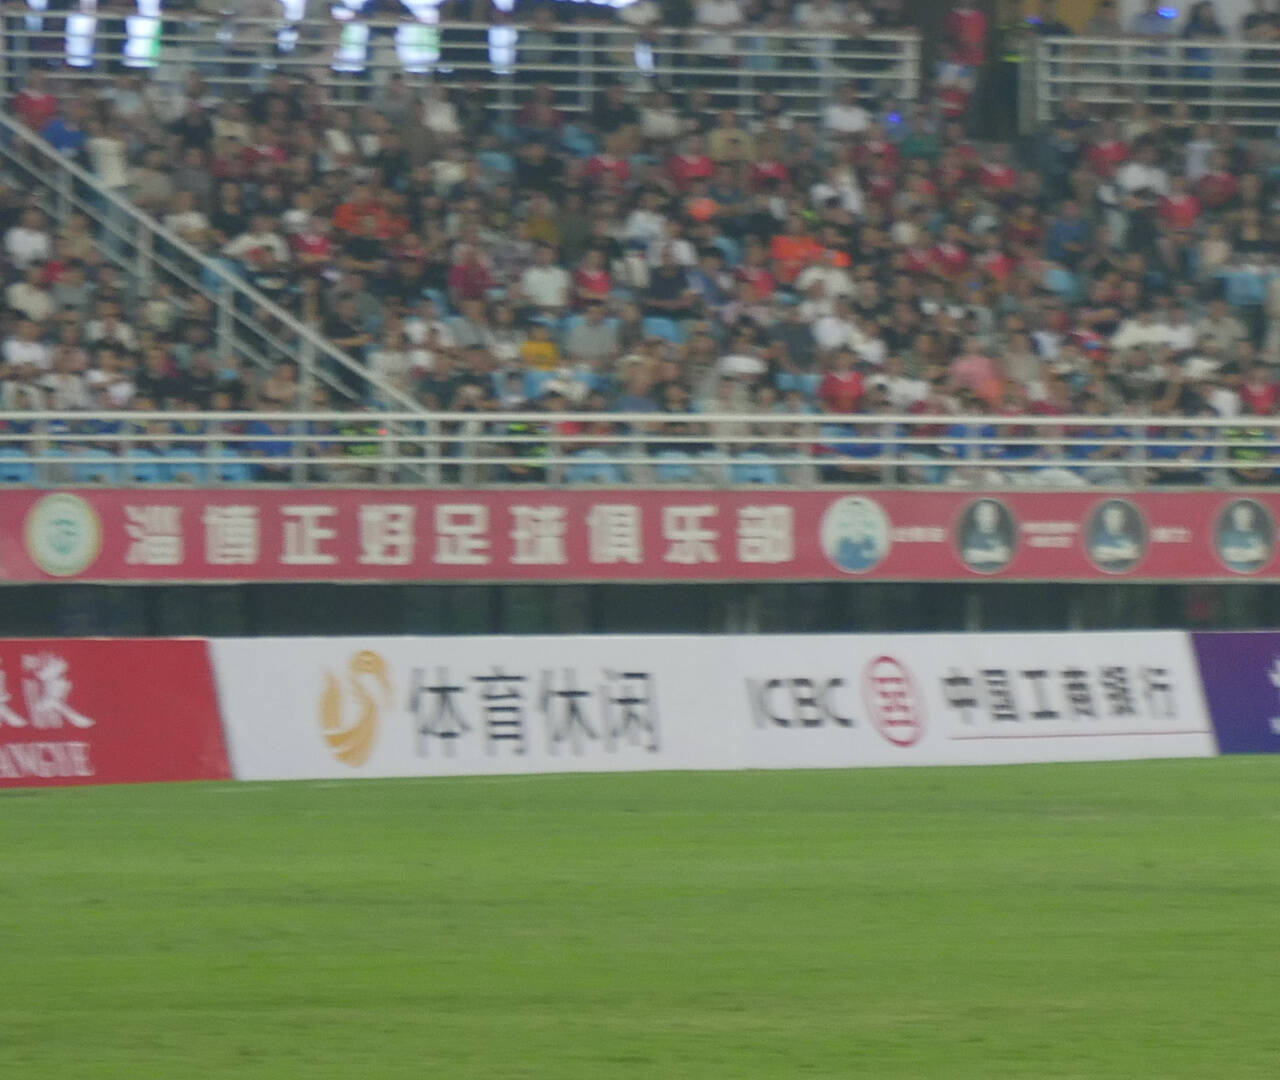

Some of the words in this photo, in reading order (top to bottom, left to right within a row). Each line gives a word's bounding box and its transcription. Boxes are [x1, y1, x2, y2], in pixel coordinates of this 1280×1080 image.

[406, 666, 662, 757] 体育休闲
[745, 676, 857, 728] ICBC
[940, 666, 1178, 723] 中国工商银行
